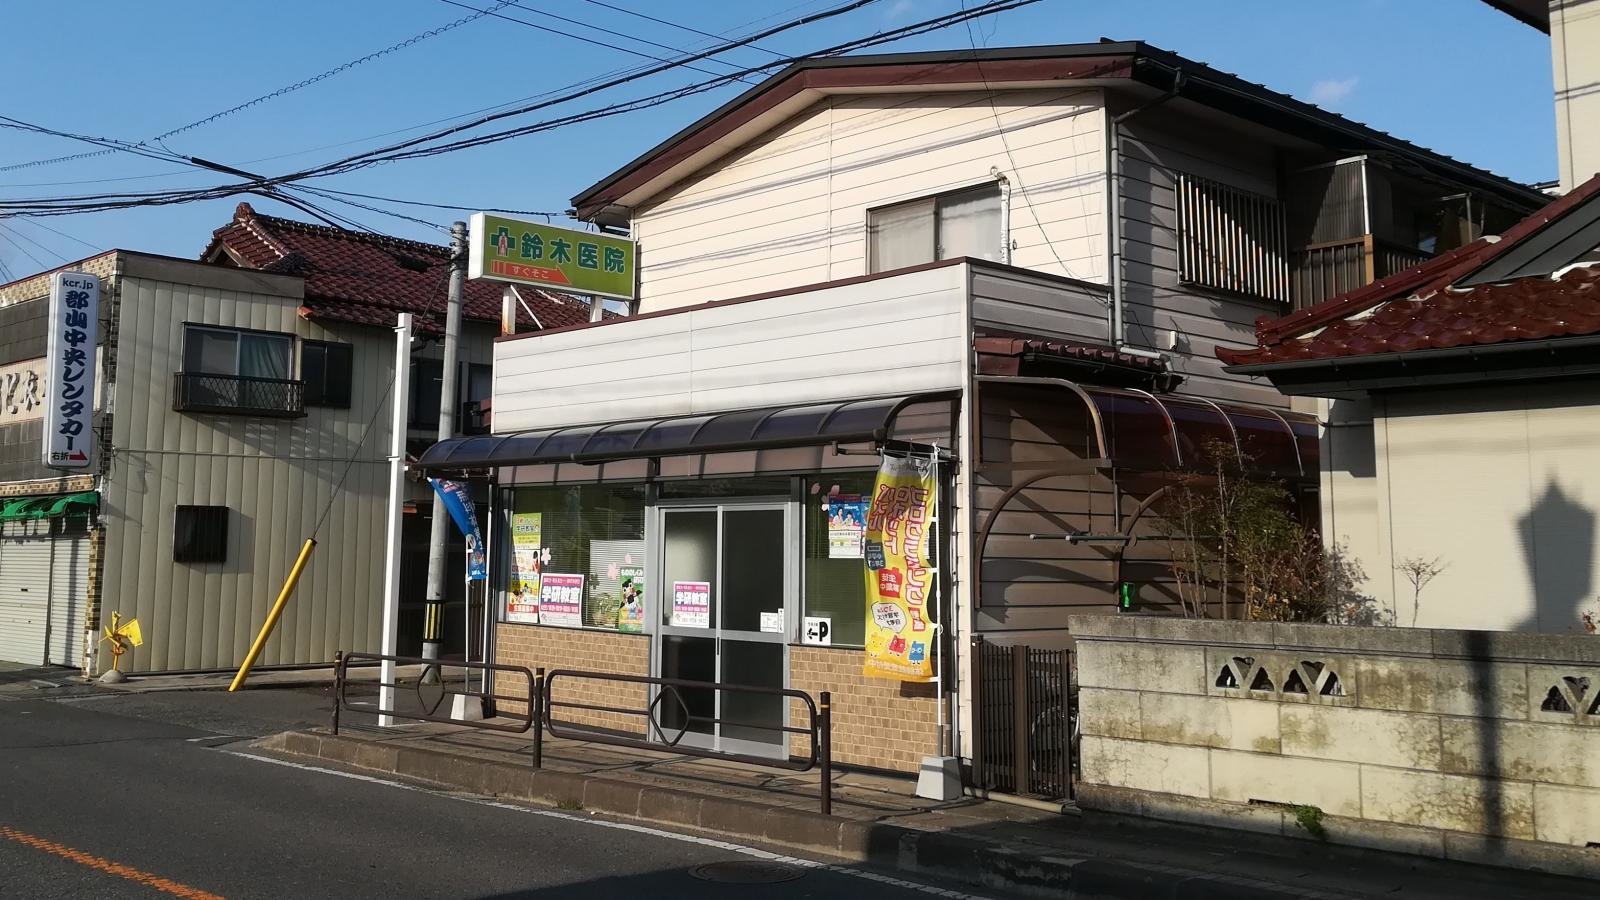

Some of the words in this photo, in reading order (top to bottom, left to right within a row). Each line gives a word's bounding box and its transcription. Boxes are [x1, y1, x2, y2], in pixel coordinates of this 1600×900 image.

[521, 231, 625, 274] 鈴木医院
[512, 265, 550, 279] すぐそこ
[62, 277, 94, 290] kcr.jp
[59, 290, 90, 451] 郡山中央レンタカー
[52, 451, 70, 461] 右折
[542, 585, 580, 604] 学研教室
[676, 592, 708, 606] 学研教室
[819, 621, 829, 642] P
